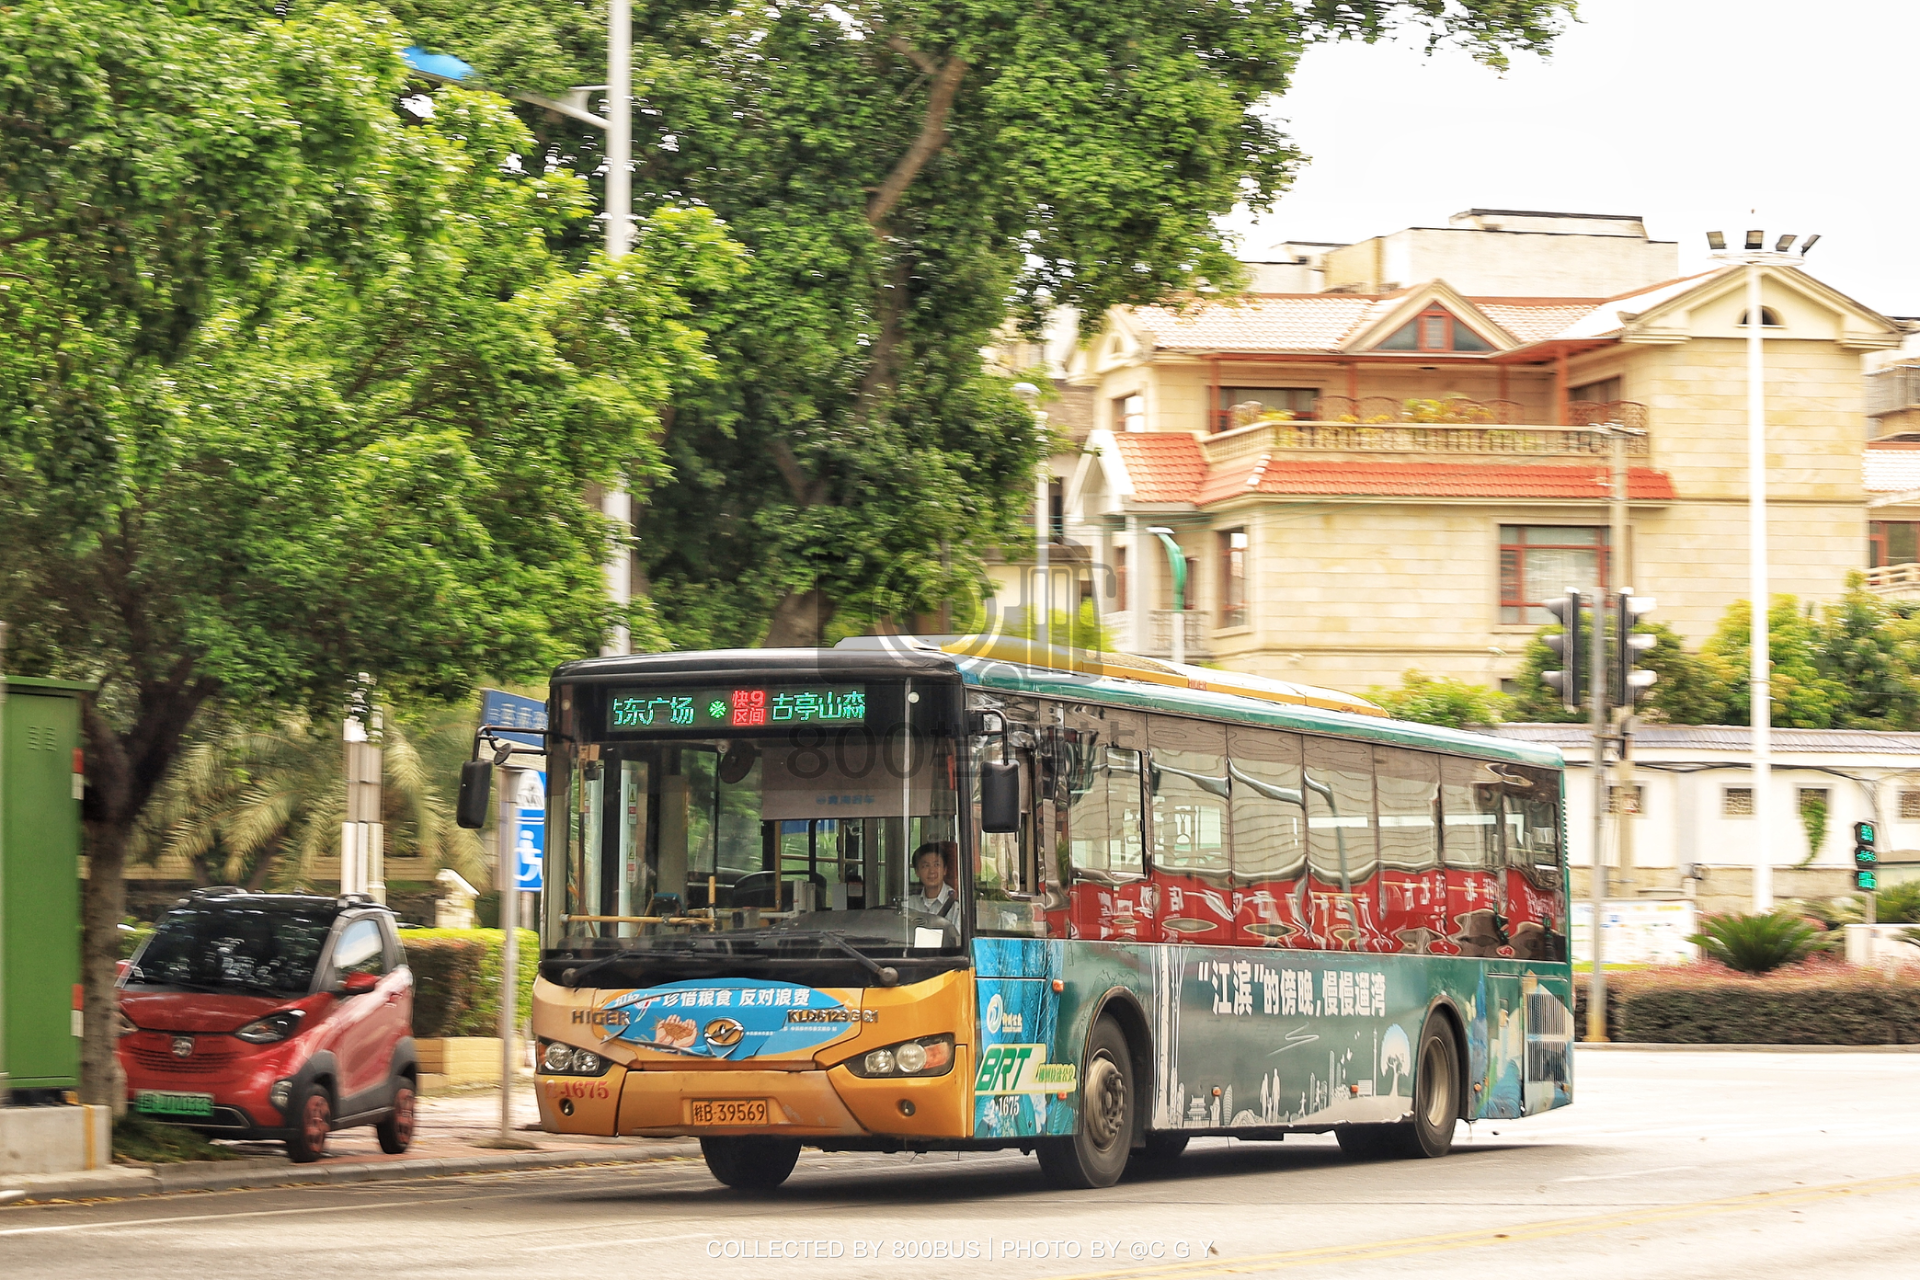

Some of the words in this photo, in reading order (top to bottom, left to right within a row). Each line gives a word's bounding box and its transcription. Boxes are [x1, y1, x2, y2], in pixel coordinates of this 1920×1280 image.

[733, 690, 765, 708] 快9
[772, 691, 866, 721] 古亭山森
[733, 708, 765, 726] 区间
[739, 988, 812, 1007] 反对浪费
[572, 1009, 630, 1025] HIGER
[976, 1047, 1033, 1090] BRT
